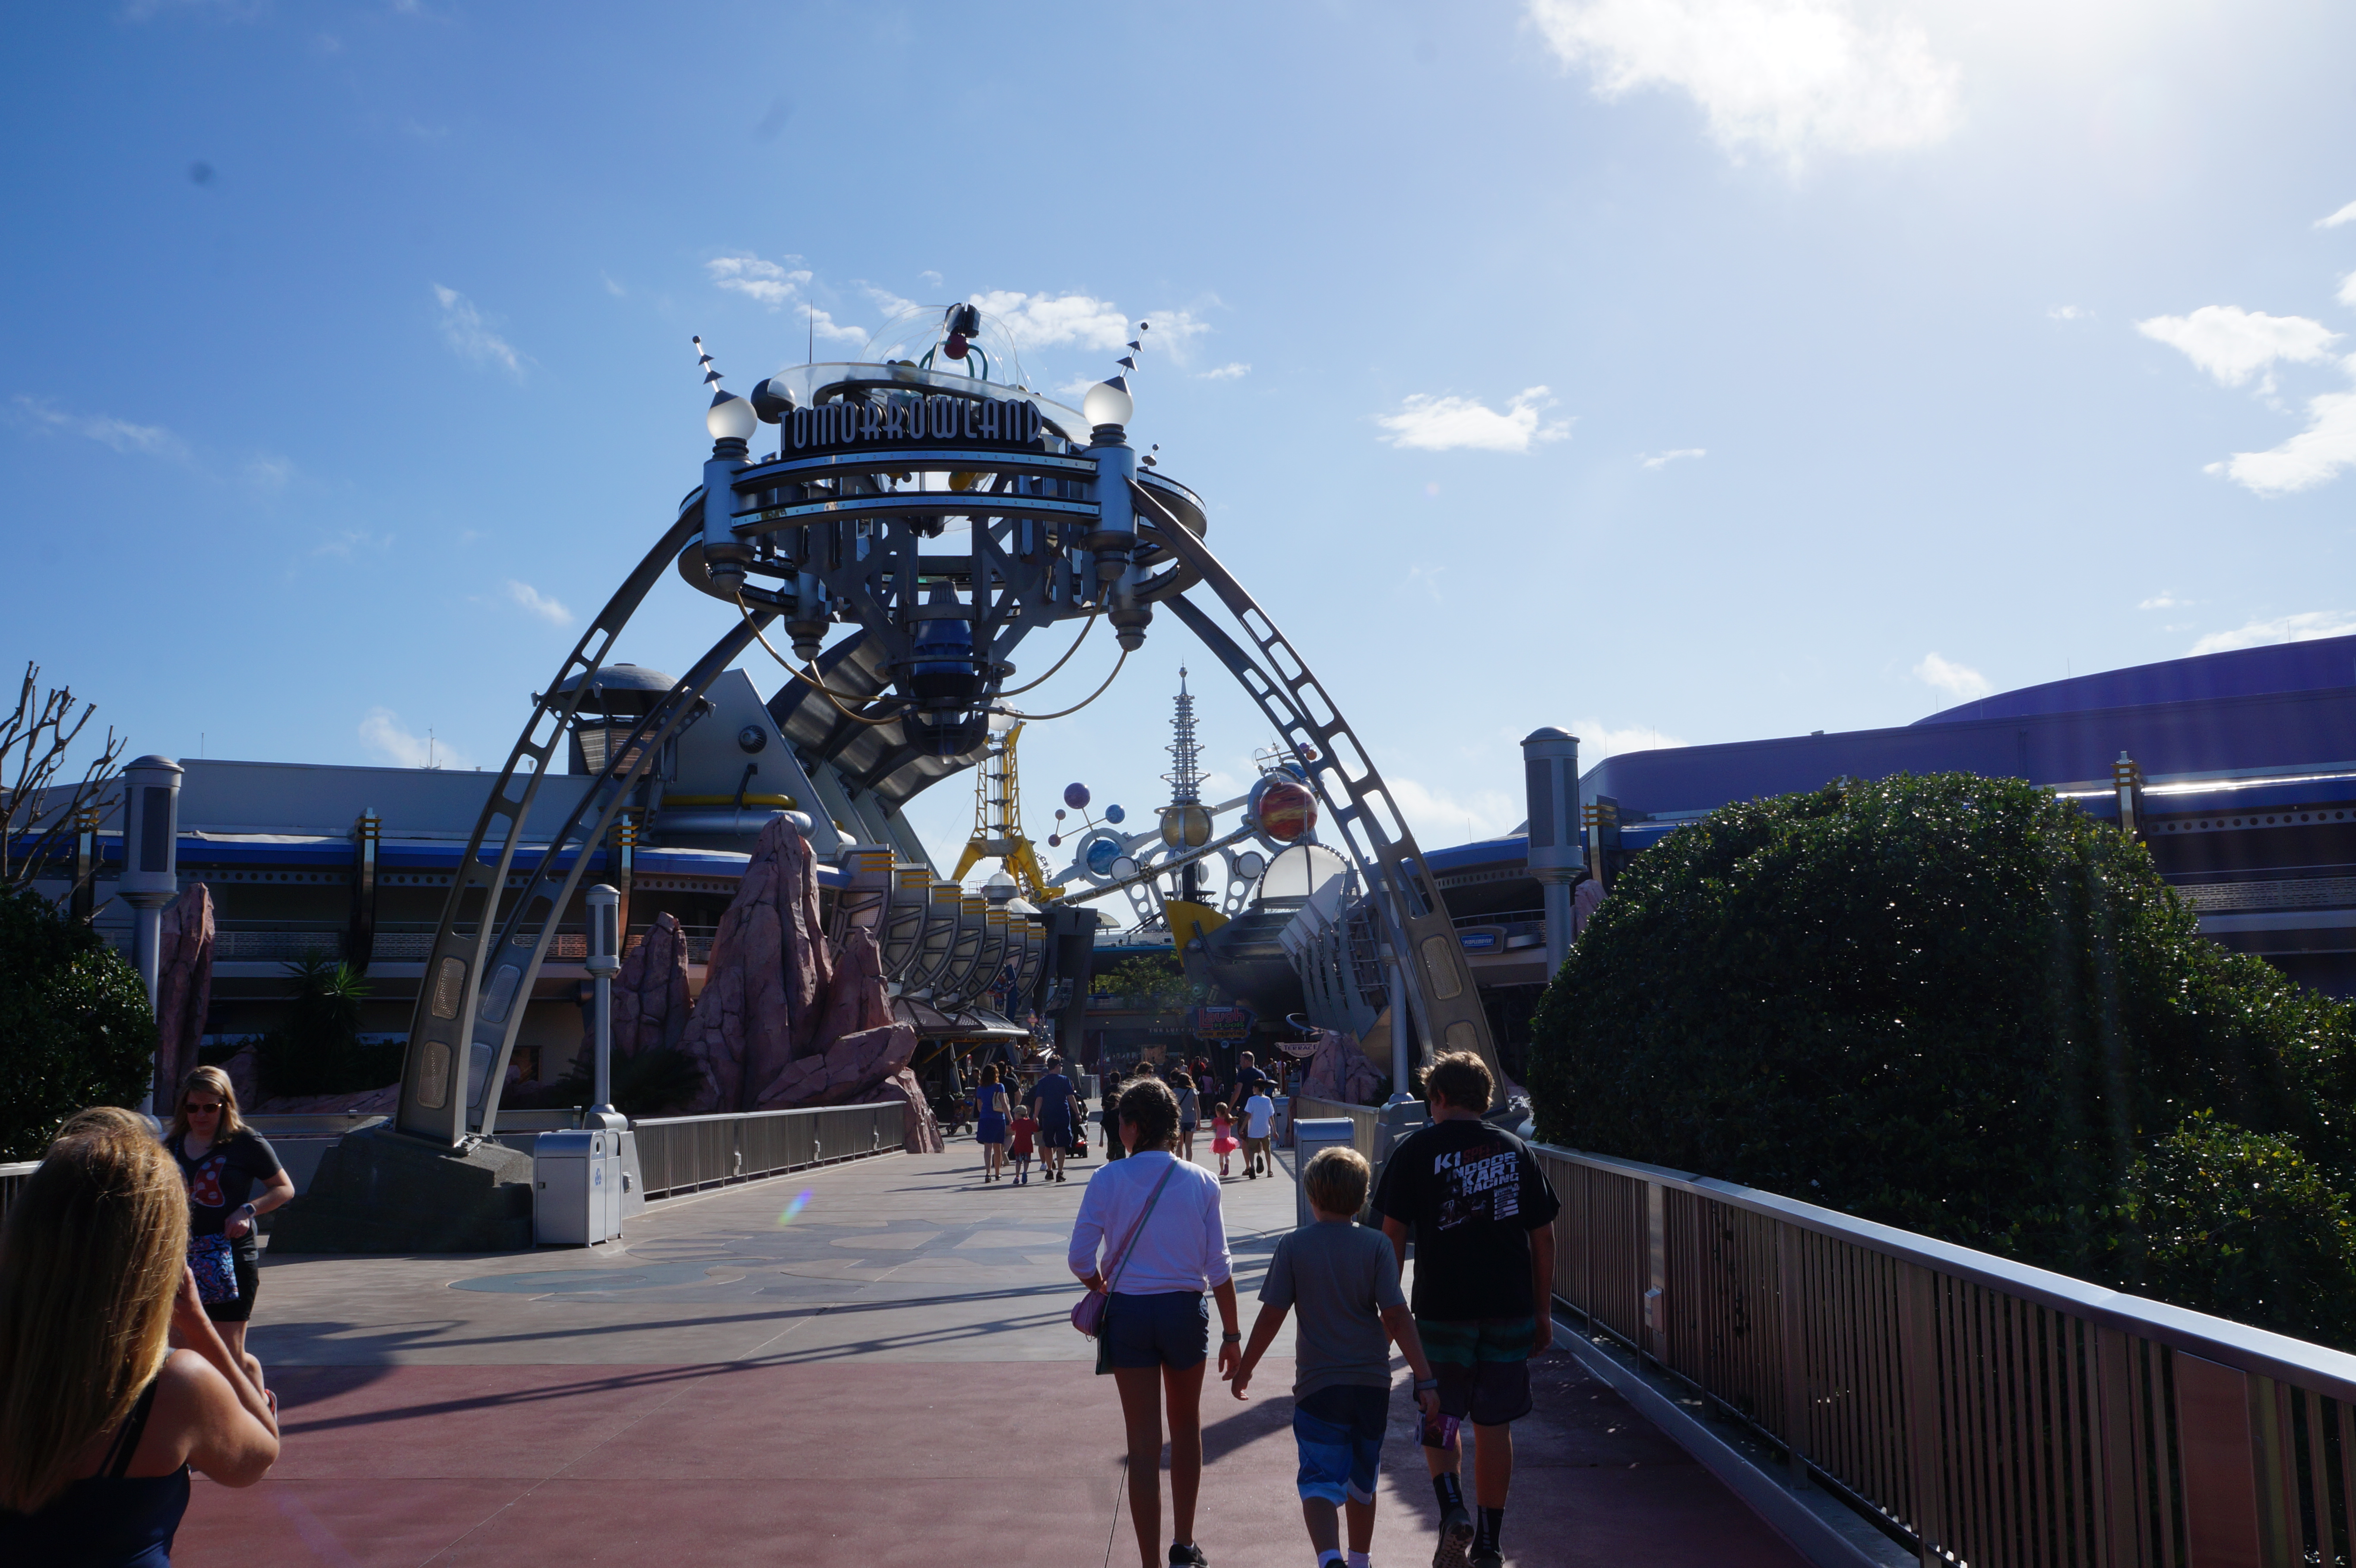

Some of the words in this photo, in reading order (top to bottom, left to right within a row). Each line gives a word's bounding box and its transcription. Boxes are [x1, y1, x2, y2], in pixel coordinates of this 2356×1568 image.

[777, 396, 1043, 452] TOMORROWLAND
[1199, 1007, 1244, 1028] Laugh
[1434, 1151, 1461, 1175] K1
[1462, 1161, 1519, 1187] KART
[1463, 1173, 1519, 1196] RACING
